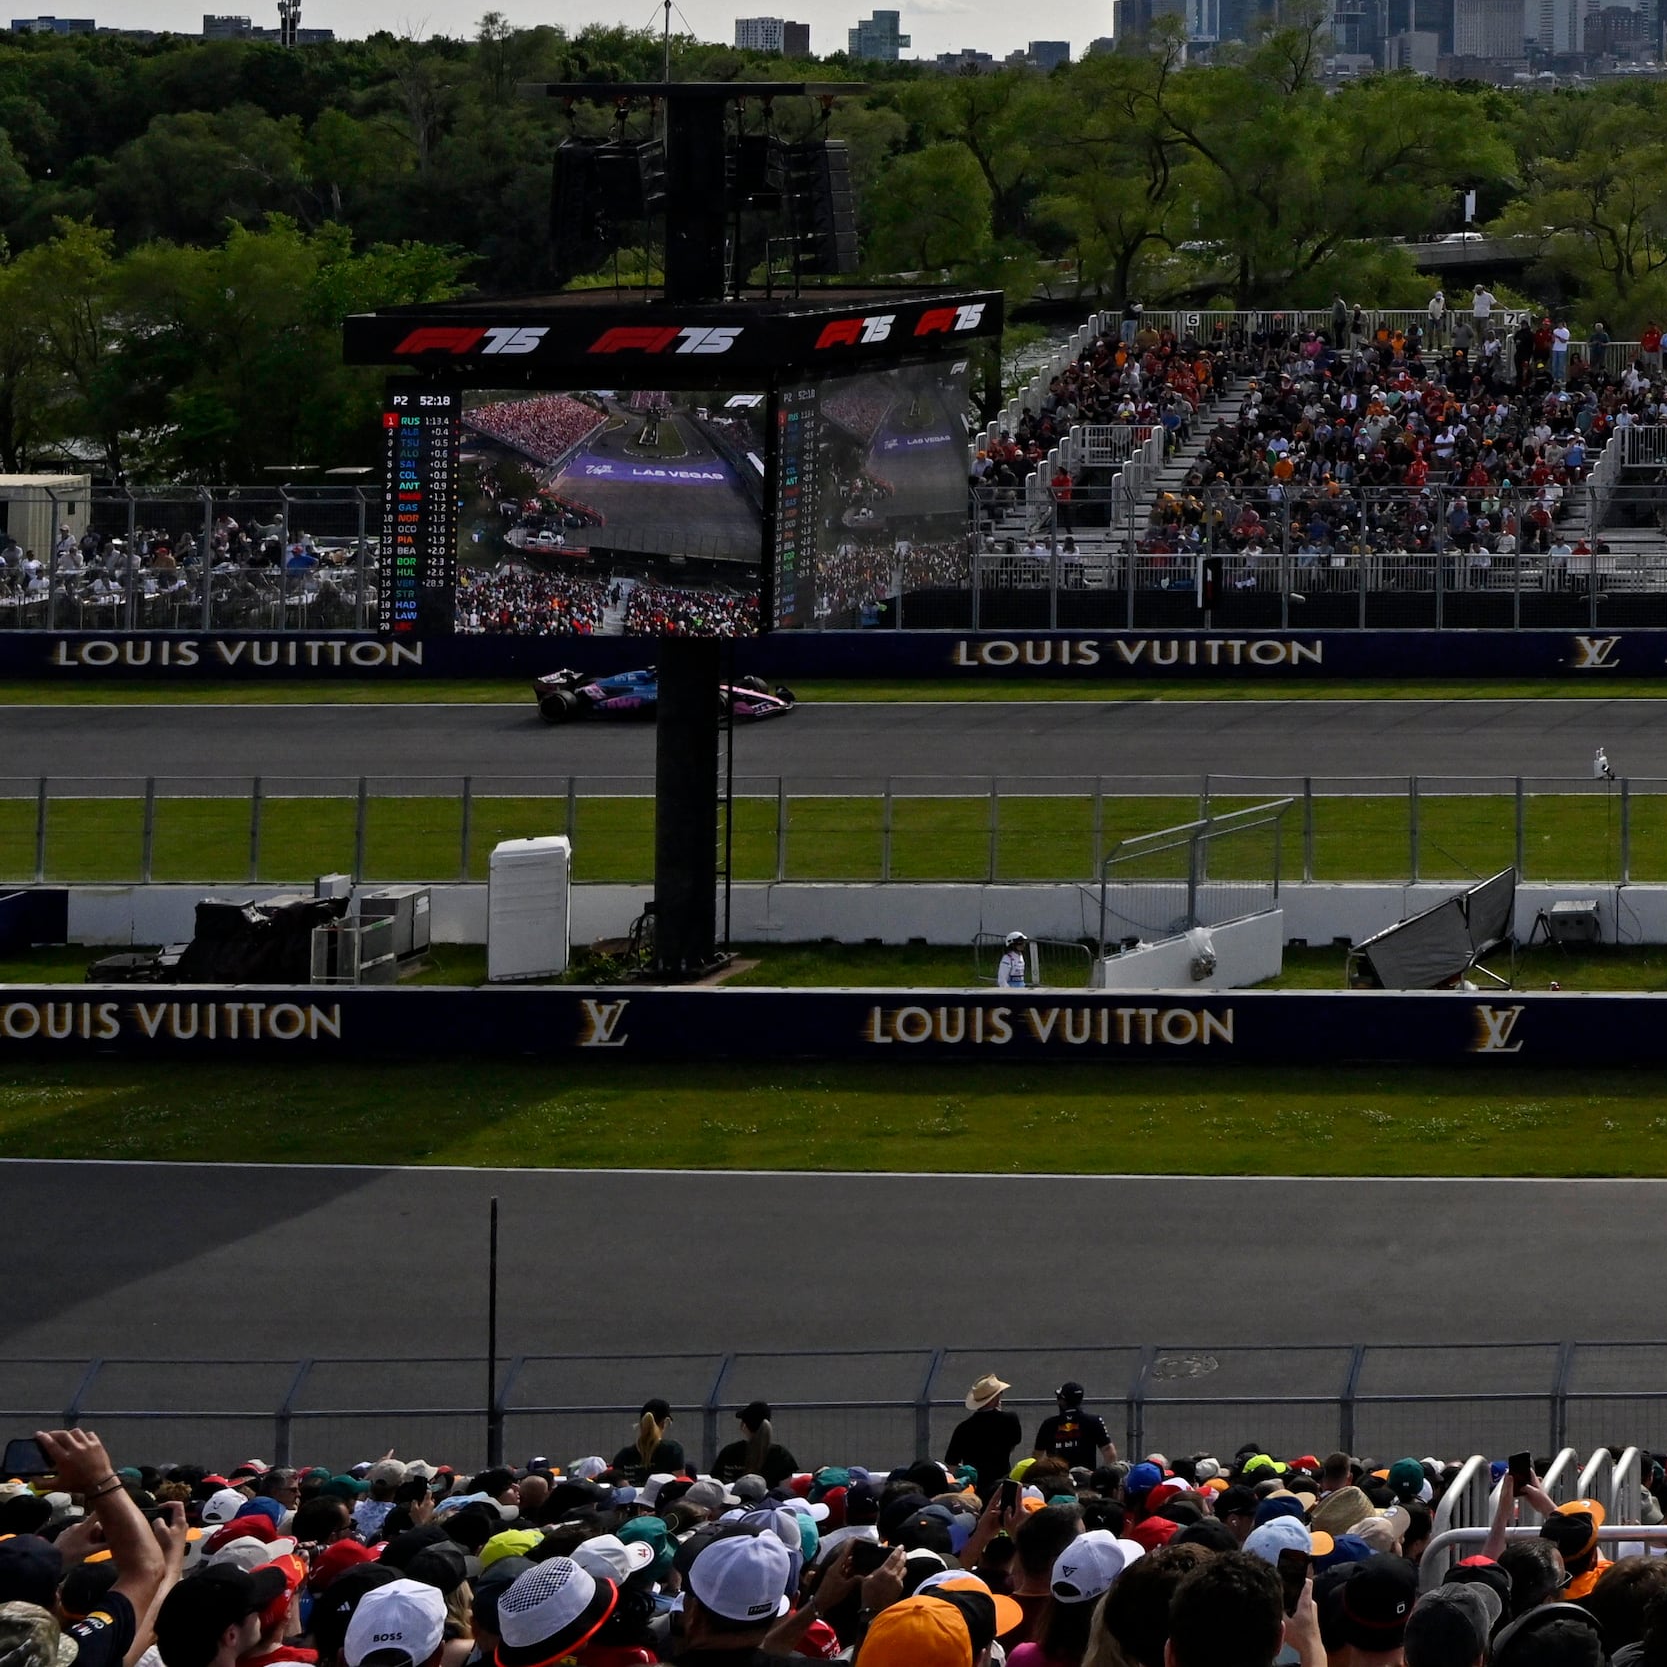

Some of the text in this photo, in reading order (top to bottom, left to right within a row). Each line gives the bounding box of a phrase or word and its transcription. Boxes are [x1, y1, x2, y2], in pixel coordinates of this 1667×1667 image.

[1188, 314, 1197, 324] 6
[1506, 313, 1515, 323] 7
[394, 396, 451, 406] P2 52:18
[401, 417, 420, 425] RUS
[399, 471, 417, 479] COL
[398, 525, 417, 533] OCO
[397, 536, 413, 544] PIA
[59, 641, 422, 666] LOUIS VUITTON
[958, 640, 1322, 666] LOUIS VUITTON
[3, 1002, 340, 1040] OUIS VUITTON
[873, 1006, 1233, 1045] LOUIS VUITTON
[373, 1632, 403, 1643] BOSS
